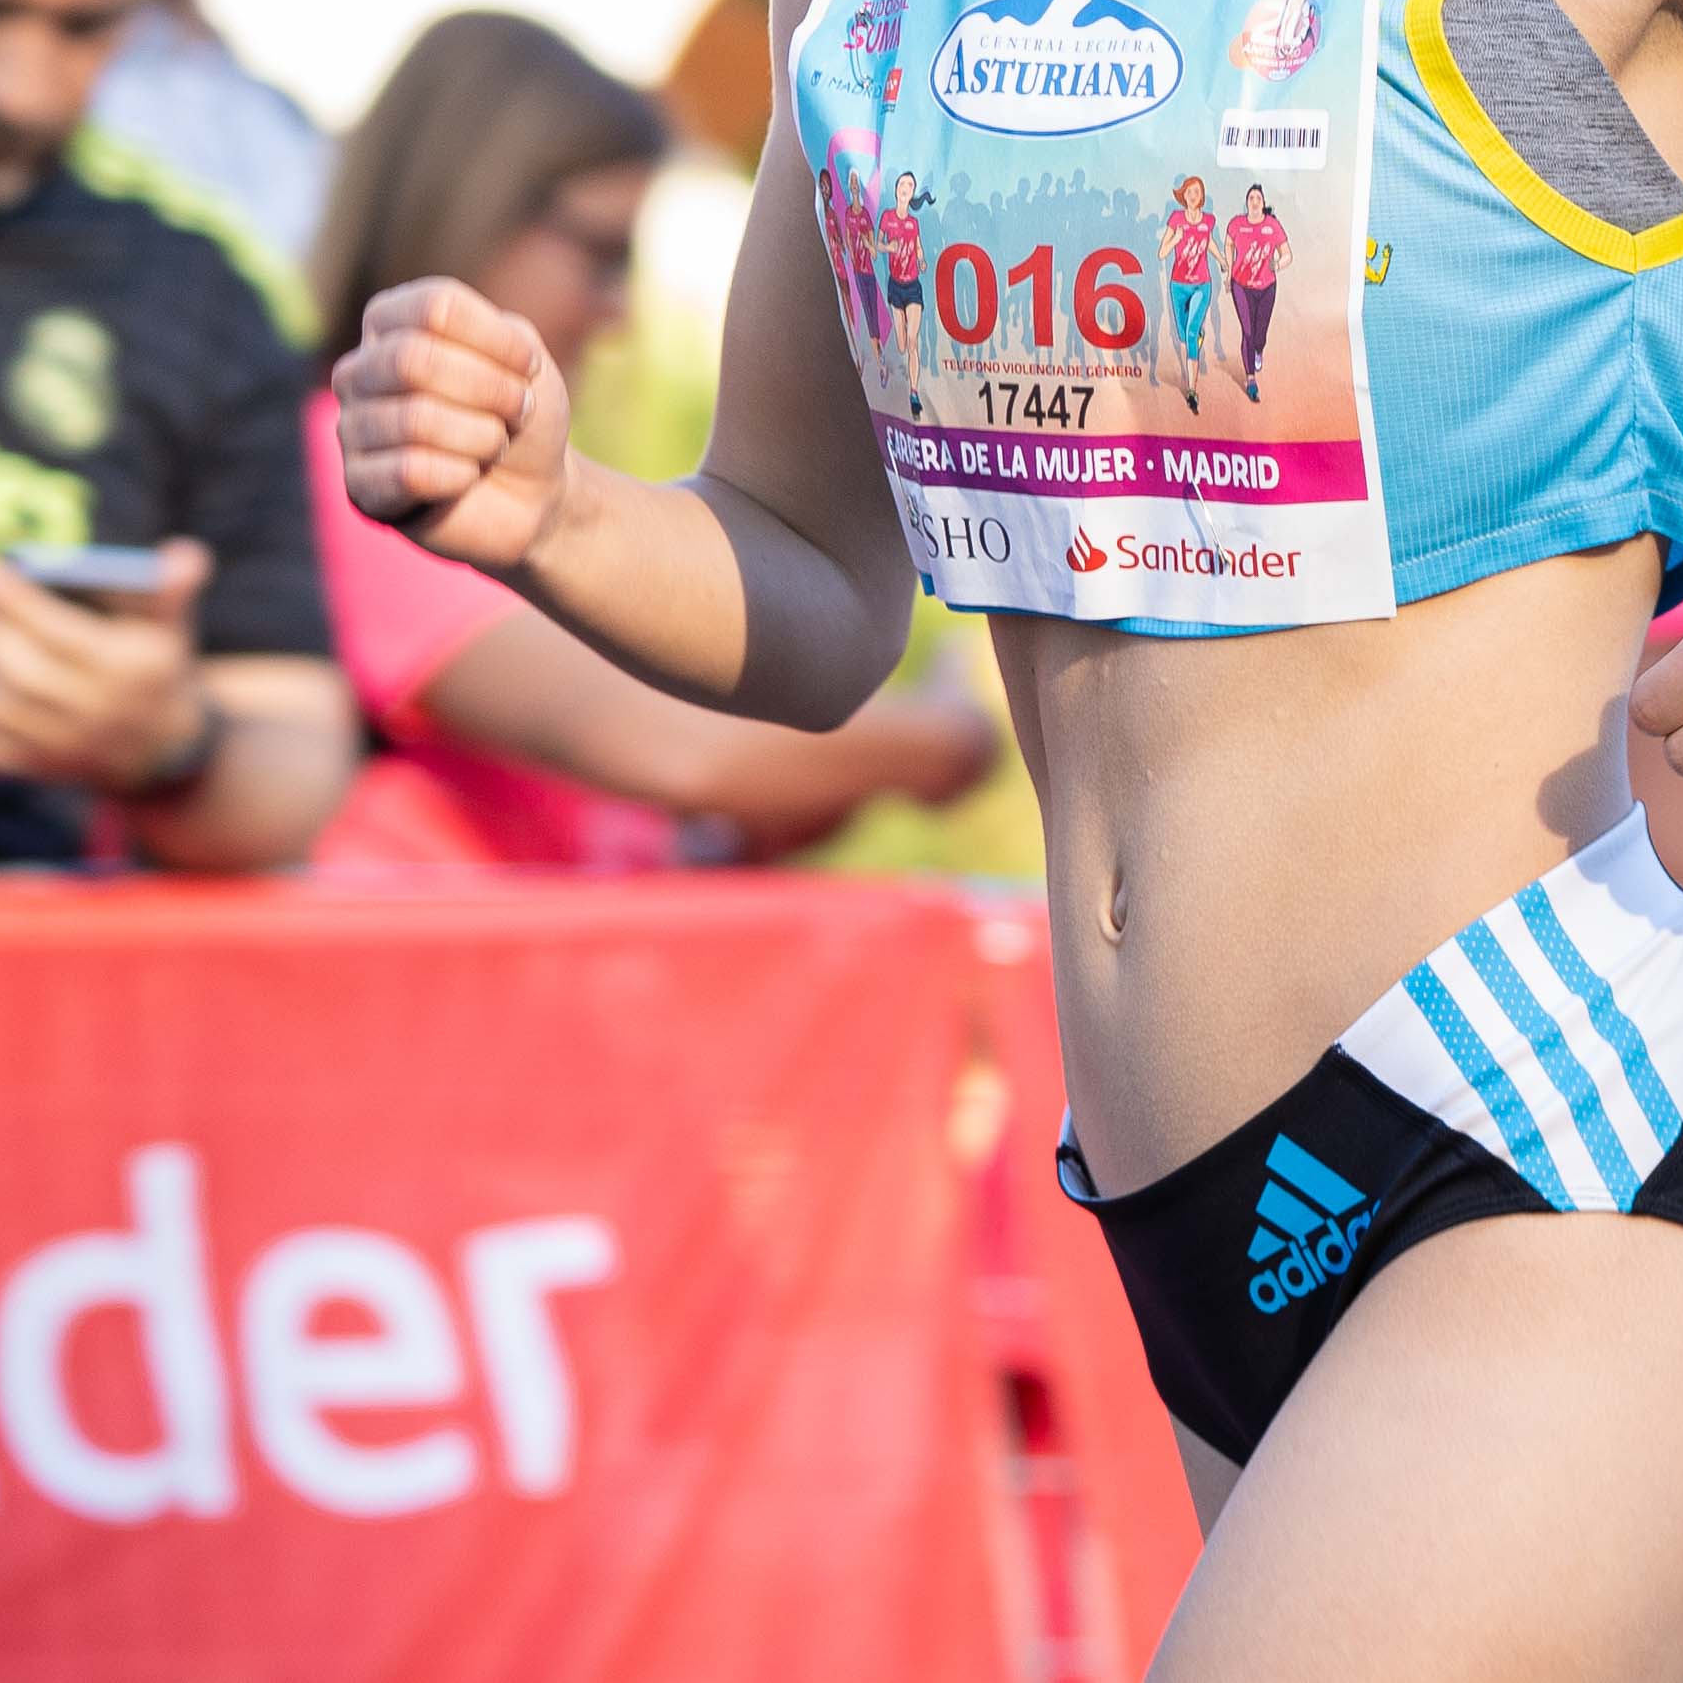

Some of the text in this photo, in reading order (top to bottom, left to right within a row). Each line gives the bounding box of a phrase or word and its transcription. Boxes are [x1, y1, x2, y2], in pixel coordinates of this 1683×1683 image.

[943, 37, 1157, 99] ASTURIANA
[979, 35, 1157, 54] CENTRAL LECHERA
[935, 242, 1147, 350] 016
[1002, 361, 1065, 377] VIOLENCIA
[1068, 364, 1081, 378] DE
[978, 381, 1095, 429] 17447
[960, 440, 992, 477] DE
[996, 443, 1028, 480] LA
[1035, 446, 1138, 484] MUJER
[1162, 448, 1280, 490] MADRID
[1116, 534, 1302, 578] Santander
